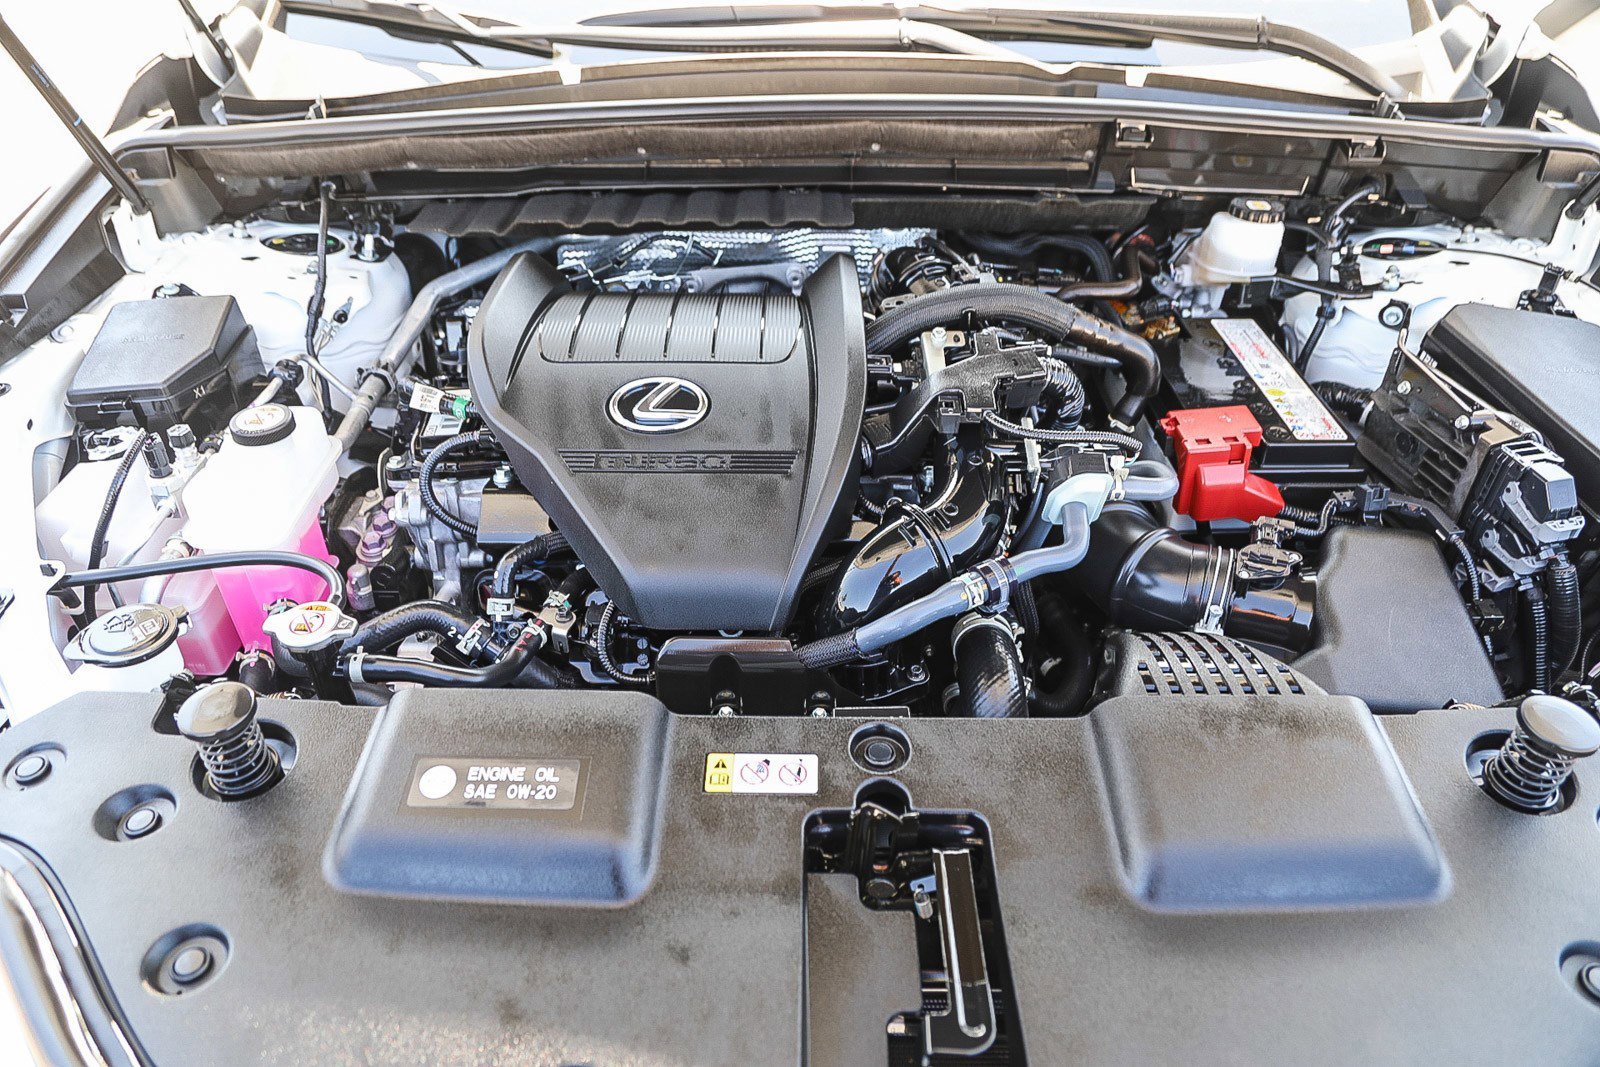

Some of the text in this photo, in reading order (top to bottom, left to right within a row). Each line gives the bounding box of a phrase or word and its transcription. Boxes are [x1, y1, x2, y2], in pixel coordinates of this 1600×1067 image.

[598, 454, 726, 469] TURBO
[468, 766, 560, 782] ENGINE OIL
[463, 784, 498, 799] SAE
